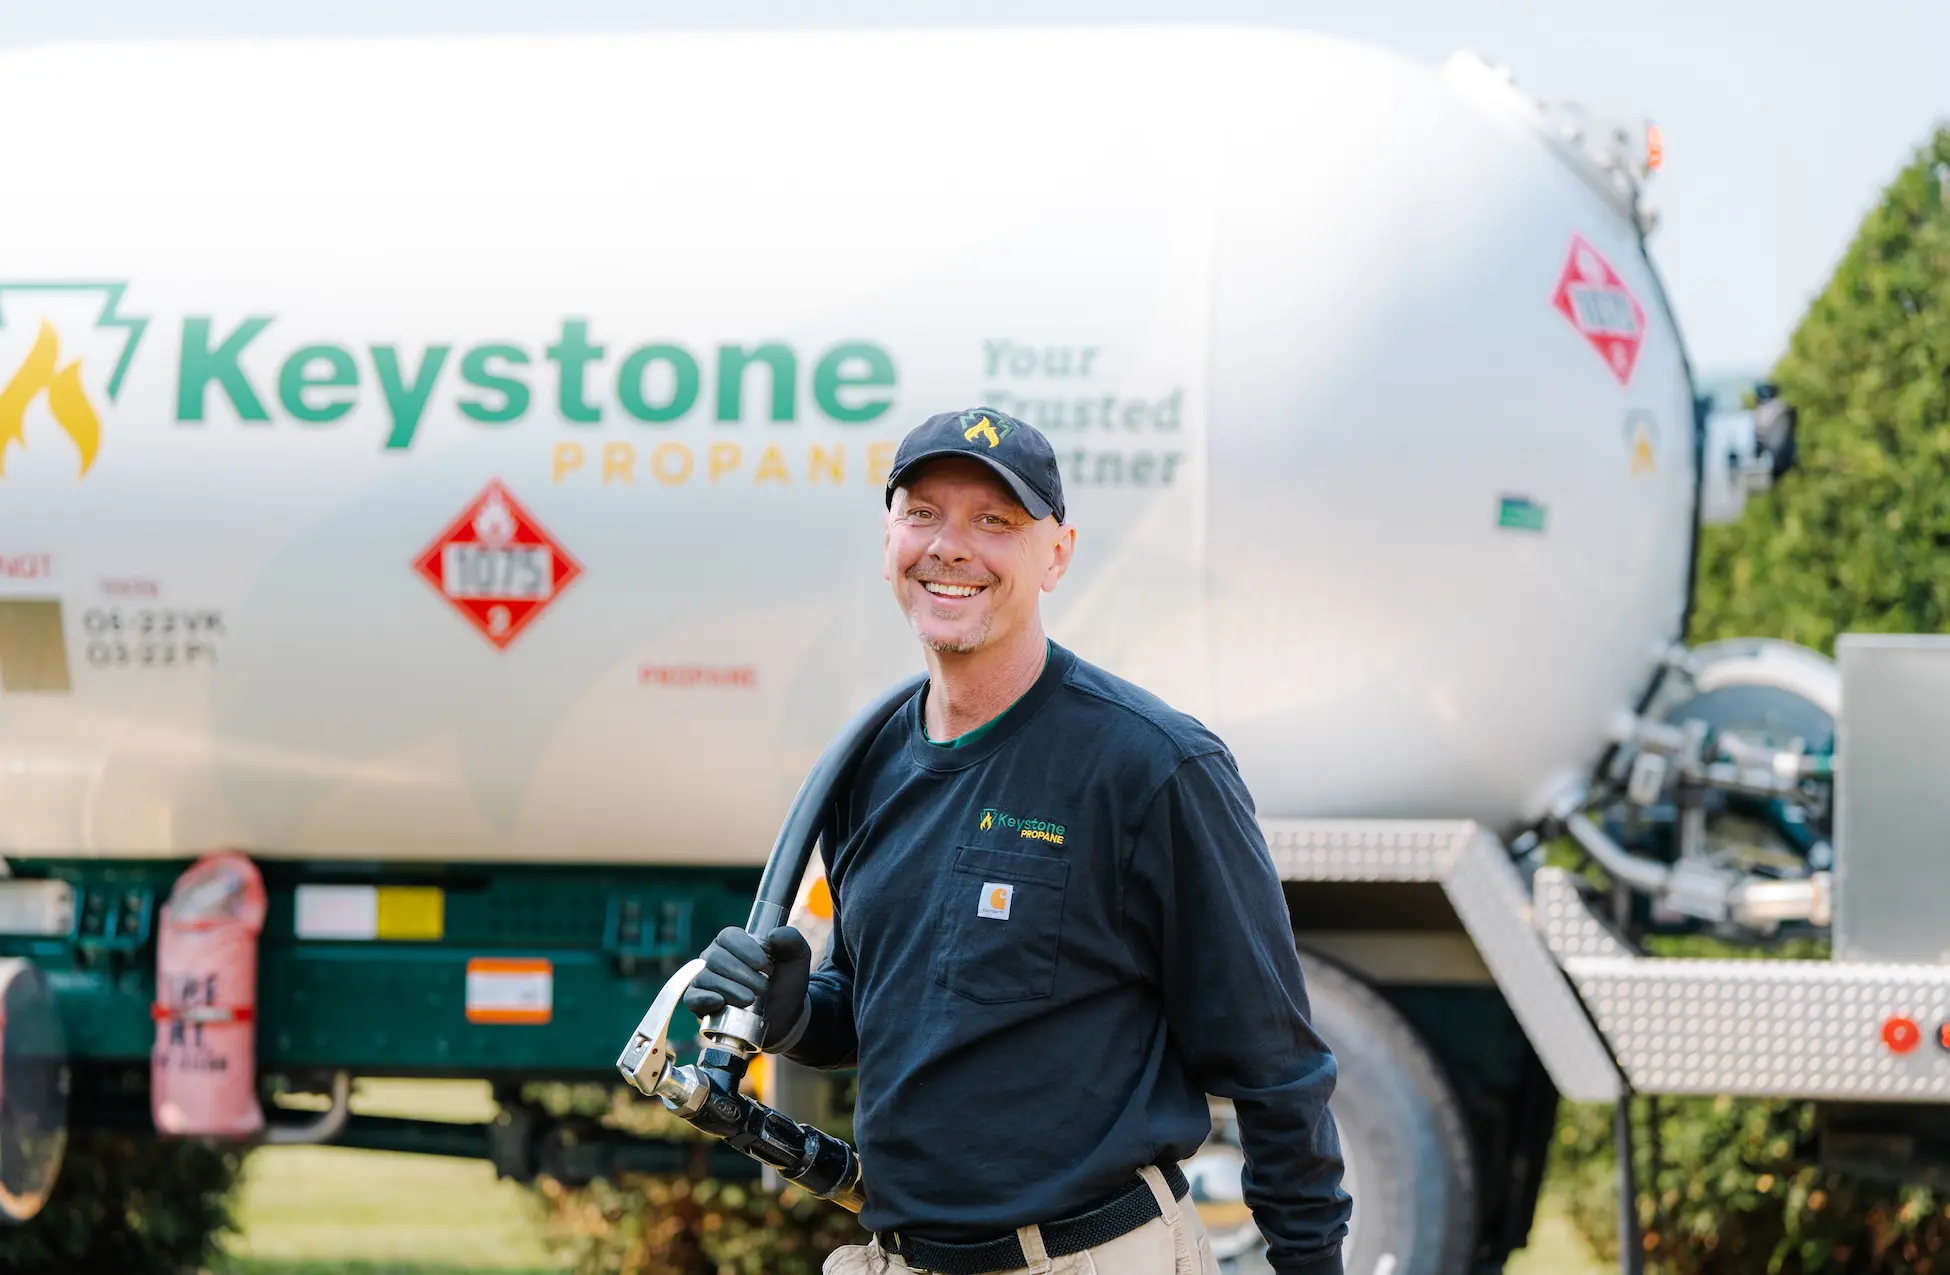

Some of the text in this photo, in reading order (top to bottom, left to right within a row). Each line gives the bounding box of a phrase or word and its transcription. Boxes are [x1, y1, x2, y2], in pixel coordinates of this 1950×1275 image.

[981, 337, 1100, 378] Your
[176, 316, 897, 449] Keystone
[981, 386, 1184, 432] Trusted
[552, 441, 896, 486] PROPANE
[457, 549, 542, 594] 1075
[997, 813, 1066, 835] Keystone
[1020, 829, 1065, 845] PROPANE
